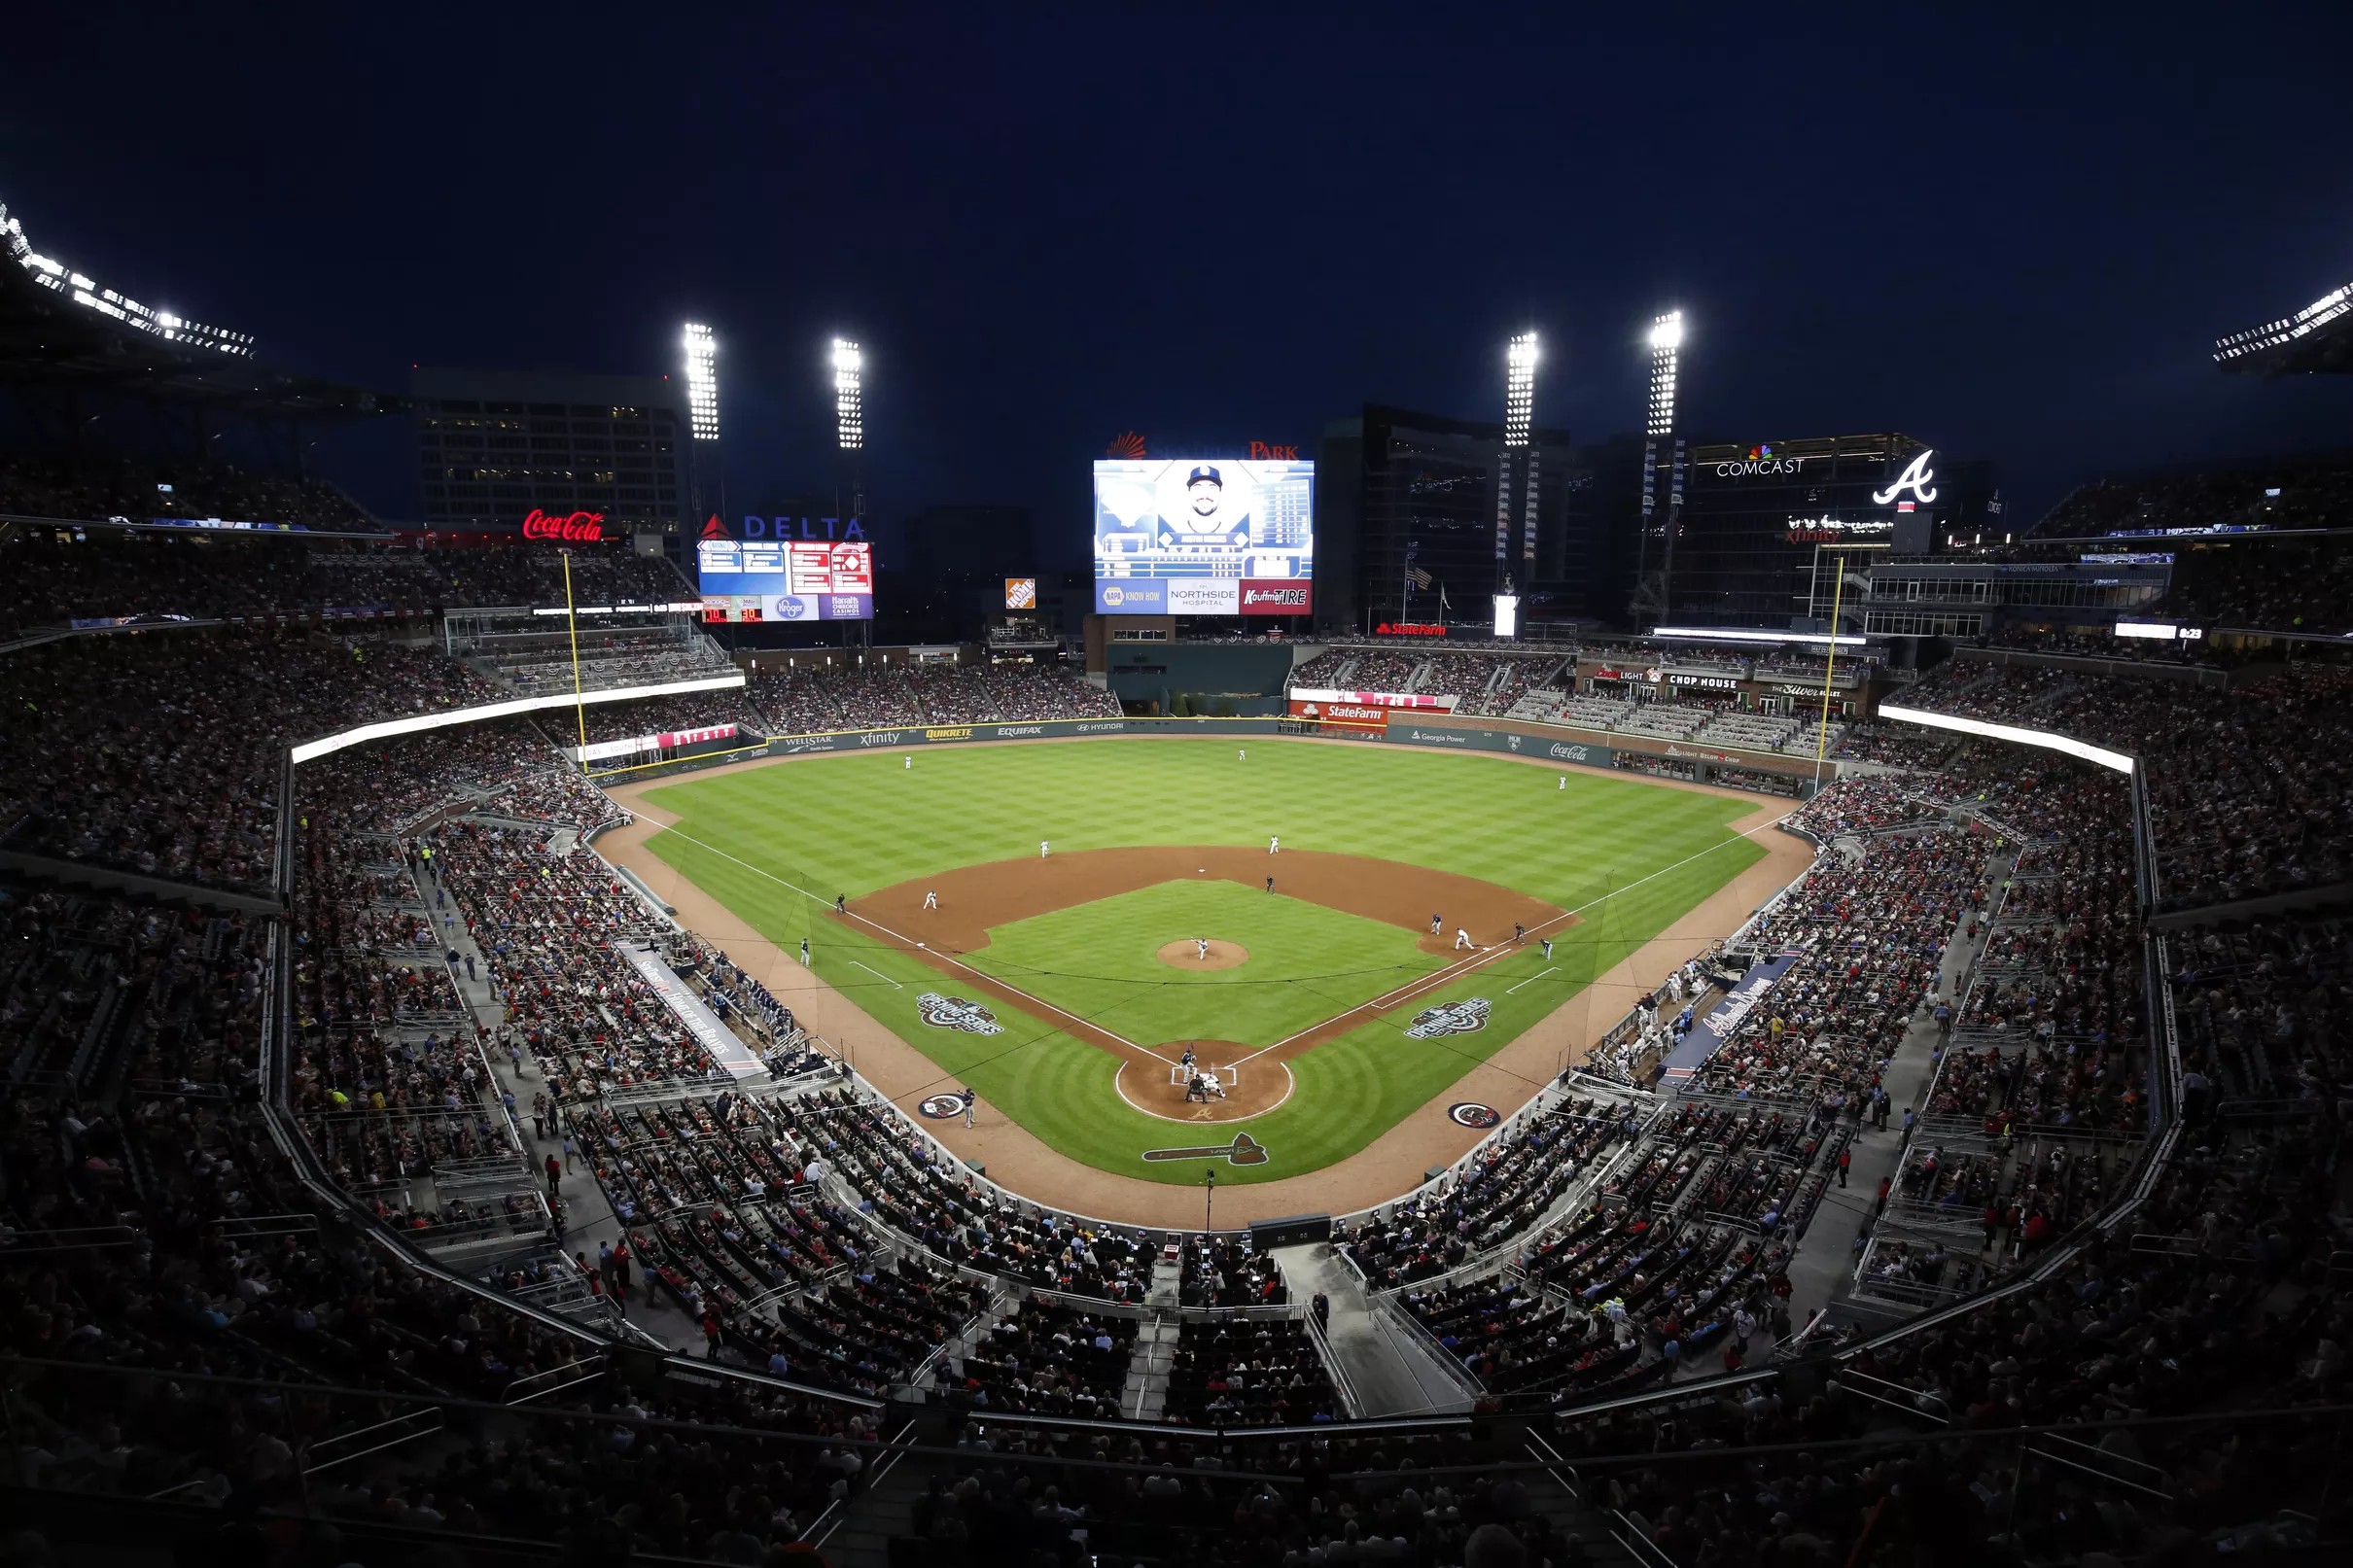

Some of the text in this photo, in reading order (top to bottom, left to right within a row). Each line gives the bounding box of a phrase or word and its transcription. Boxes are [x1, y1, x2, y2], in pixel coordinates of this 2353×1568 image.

[1250, 440, 1299, 460] PARK
[1717, 459, 1805, 476] COMCAST
[1873, 449, 1938, 505] A
[523, 508, 605, 541] Coca-Cola
[744, 515, 863, 540] DELTA
[1784, 528, 1841, 544] xfinity
[1007, 579, 1035, 608] HOME
[1018, 589, 1035, 608] DEPOT
[1126, 592, 1143, 601] KNOW
[1145, 592, 1160, 601] HOW
[1171, 590, 1236, 599] NORTHSIDE
[1274, 589, 1307, 605] TIRE
[778, 600, 803, 617] Kroger
[2179, 628, 2202, 639] 8:23
[1620, 672, 1643, 680] LIGHT
[1669, 675, 1737, 689] CHOP HOUSE
[1783, 684, 1818, 696] Silver
[860, 732, 900, 746] xfinity
[926, 728, 972, 738] QUIKRETE
[998, 726, 1042, 737] EQUIFAX
[1422, 733, 1445, 742] Georgia
[786, 736, 831, 746] WELLSTAR
[1550, 743, 1589, 761] Coca-Cola
[919, 993, 1002, 1034] OPENING SERIES
[1406, 997, 1491, 1038] OPENING SERIES
[668, 993, 690, 1012] HOME
[688, 1017, 708, 1031] THE
[699, 1027, 729, 1055] BRAVES
